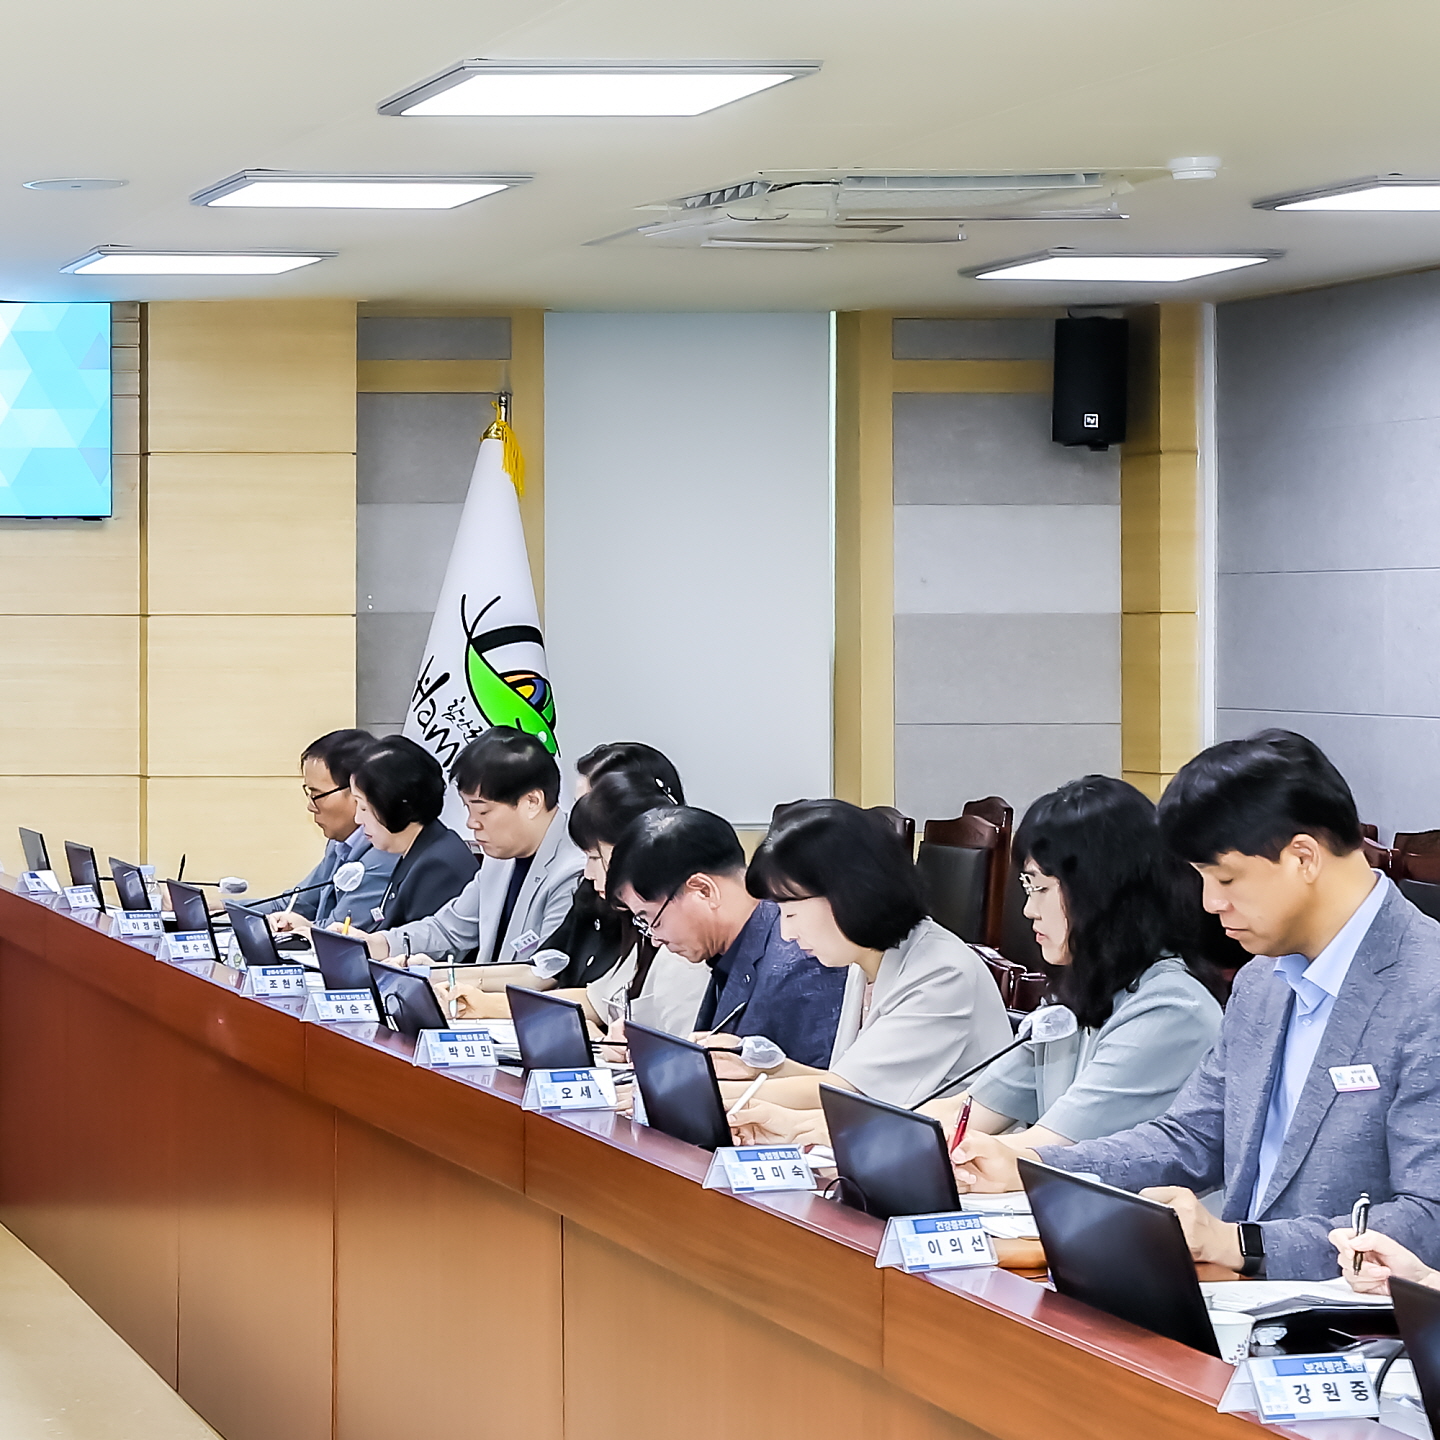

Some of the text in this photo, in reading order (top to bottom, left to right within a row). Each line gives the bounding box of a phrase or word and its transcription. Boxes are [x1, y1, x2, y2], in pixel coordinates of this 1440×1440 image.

[751, 1165, 805, 1181] 김미숙
[927, 1234, 986, 1256] 이의선
[1293, 1380, 1369, 1405] 강원중
